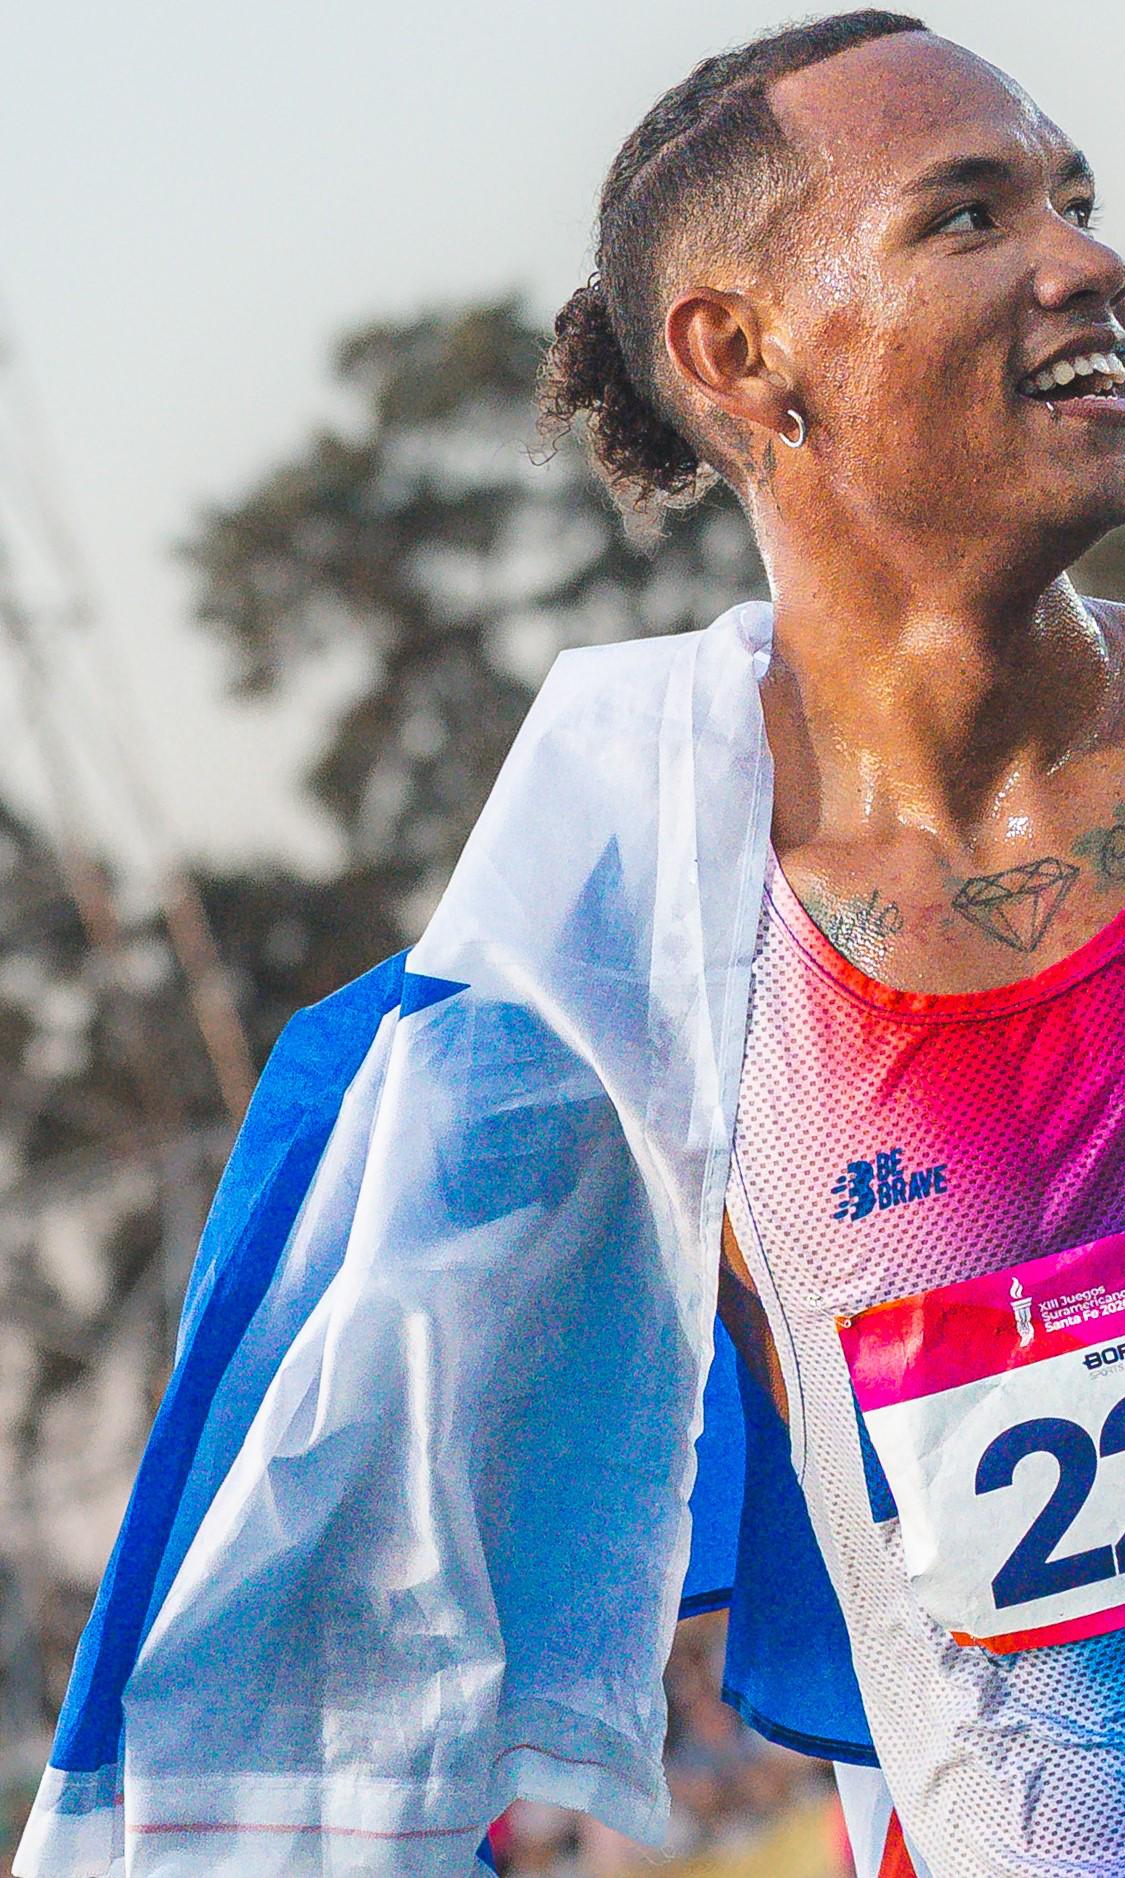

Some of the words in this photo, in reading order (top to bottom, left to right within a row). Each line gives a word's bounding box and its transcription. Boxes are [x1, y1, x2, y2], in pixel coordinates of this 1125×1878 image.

[876, 1147, 904, 1182] BE
[877, 1163, 948, 1211] BRAVE
[1038, 1298, 1059, 1313] XIII
[1060, 1285, 1106, 1306] Juegos
[1044, 1315, 1082, 1333] Santa
[1082, 1309, 1100, 1322] Fe
